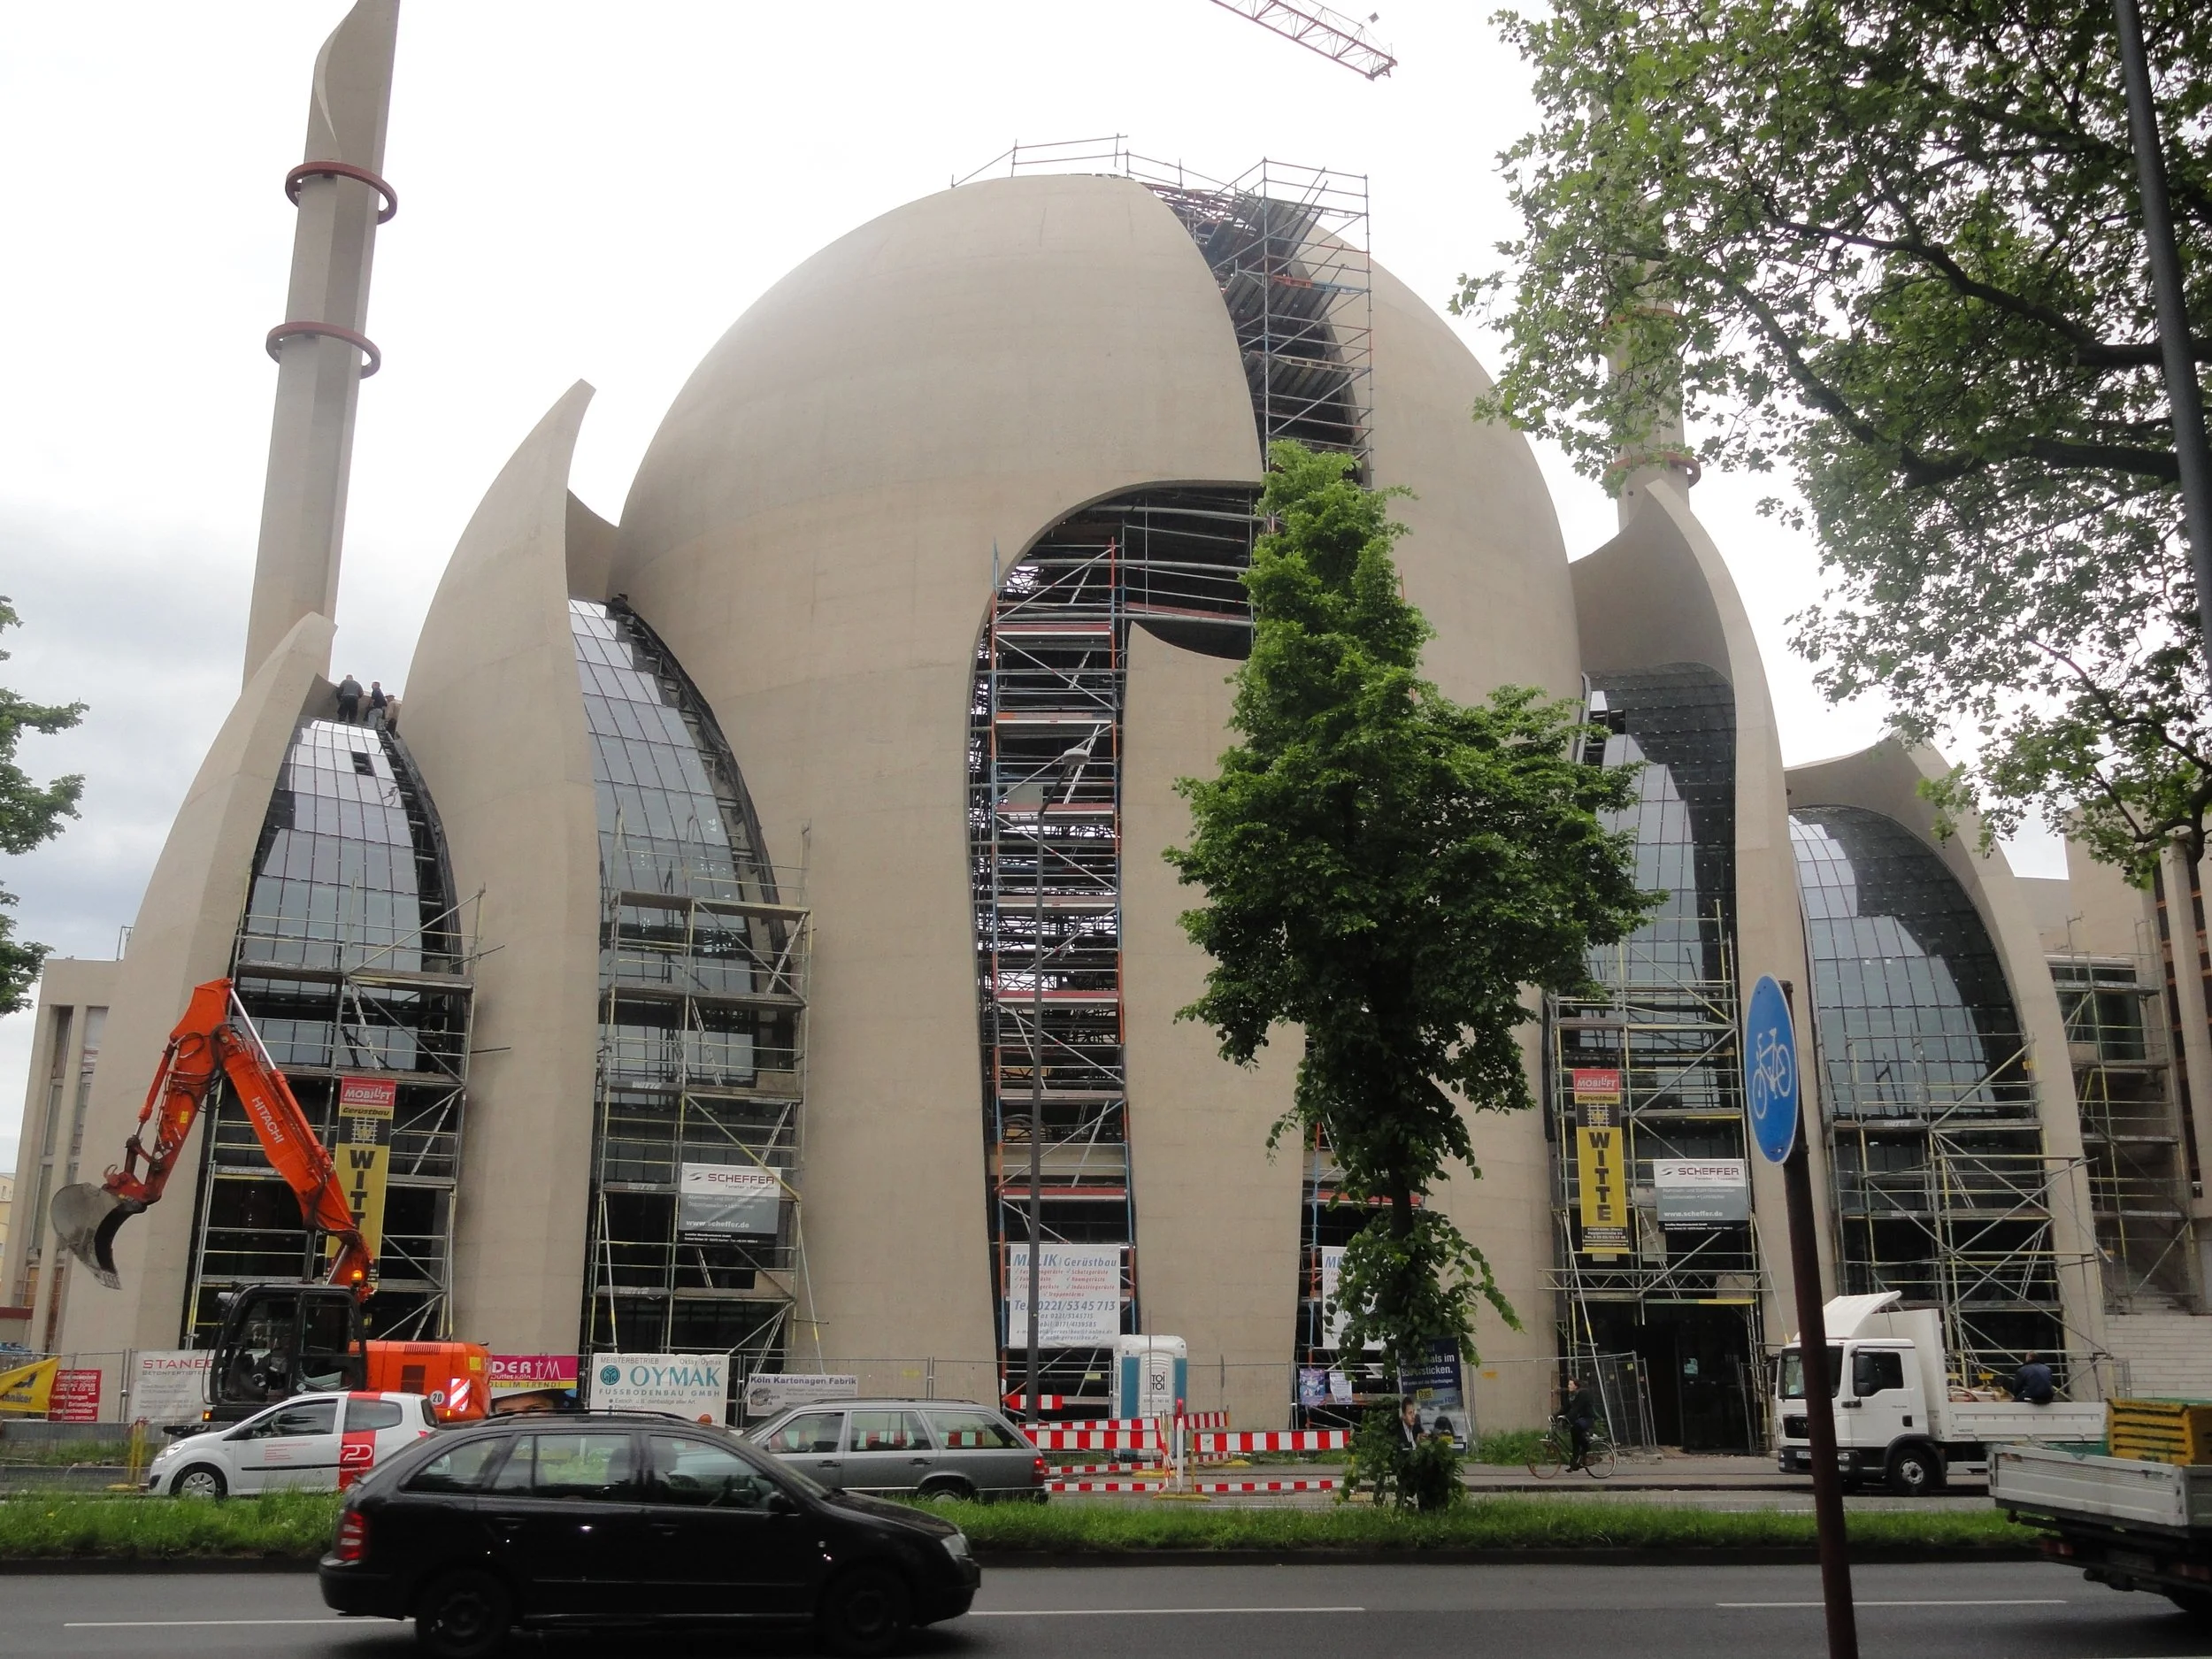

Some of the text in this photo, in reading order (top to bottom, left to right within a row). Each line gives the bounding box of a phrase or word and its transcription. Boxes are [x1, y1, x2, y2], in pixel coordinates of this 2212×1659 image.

[251, 1096, 284, 1143] HITACHI
[1588, 1132, 1612, 1221] WITTE
[1678, 1167, 1740, 1177] SCHEFFER
[708, 1173, 775, 1185] SCHEFFER
[349, 1149, 376, 1230] WITT
[1064, 1256, 1117, 1267] Gerüstbau
[1081, 1301, 1094, 1310] 45
[1097, 1301, 1116, 1310] 713
[600, 1356, 659, 1365] MEISTERBETRIEB
[1430, 1353, 1455, 1363] als im
[630, 1365, 721, 1387] OYMAK
[773, 1376, 826, 1386] Kartonagen
[433, 1393, 442, 1403] 20
